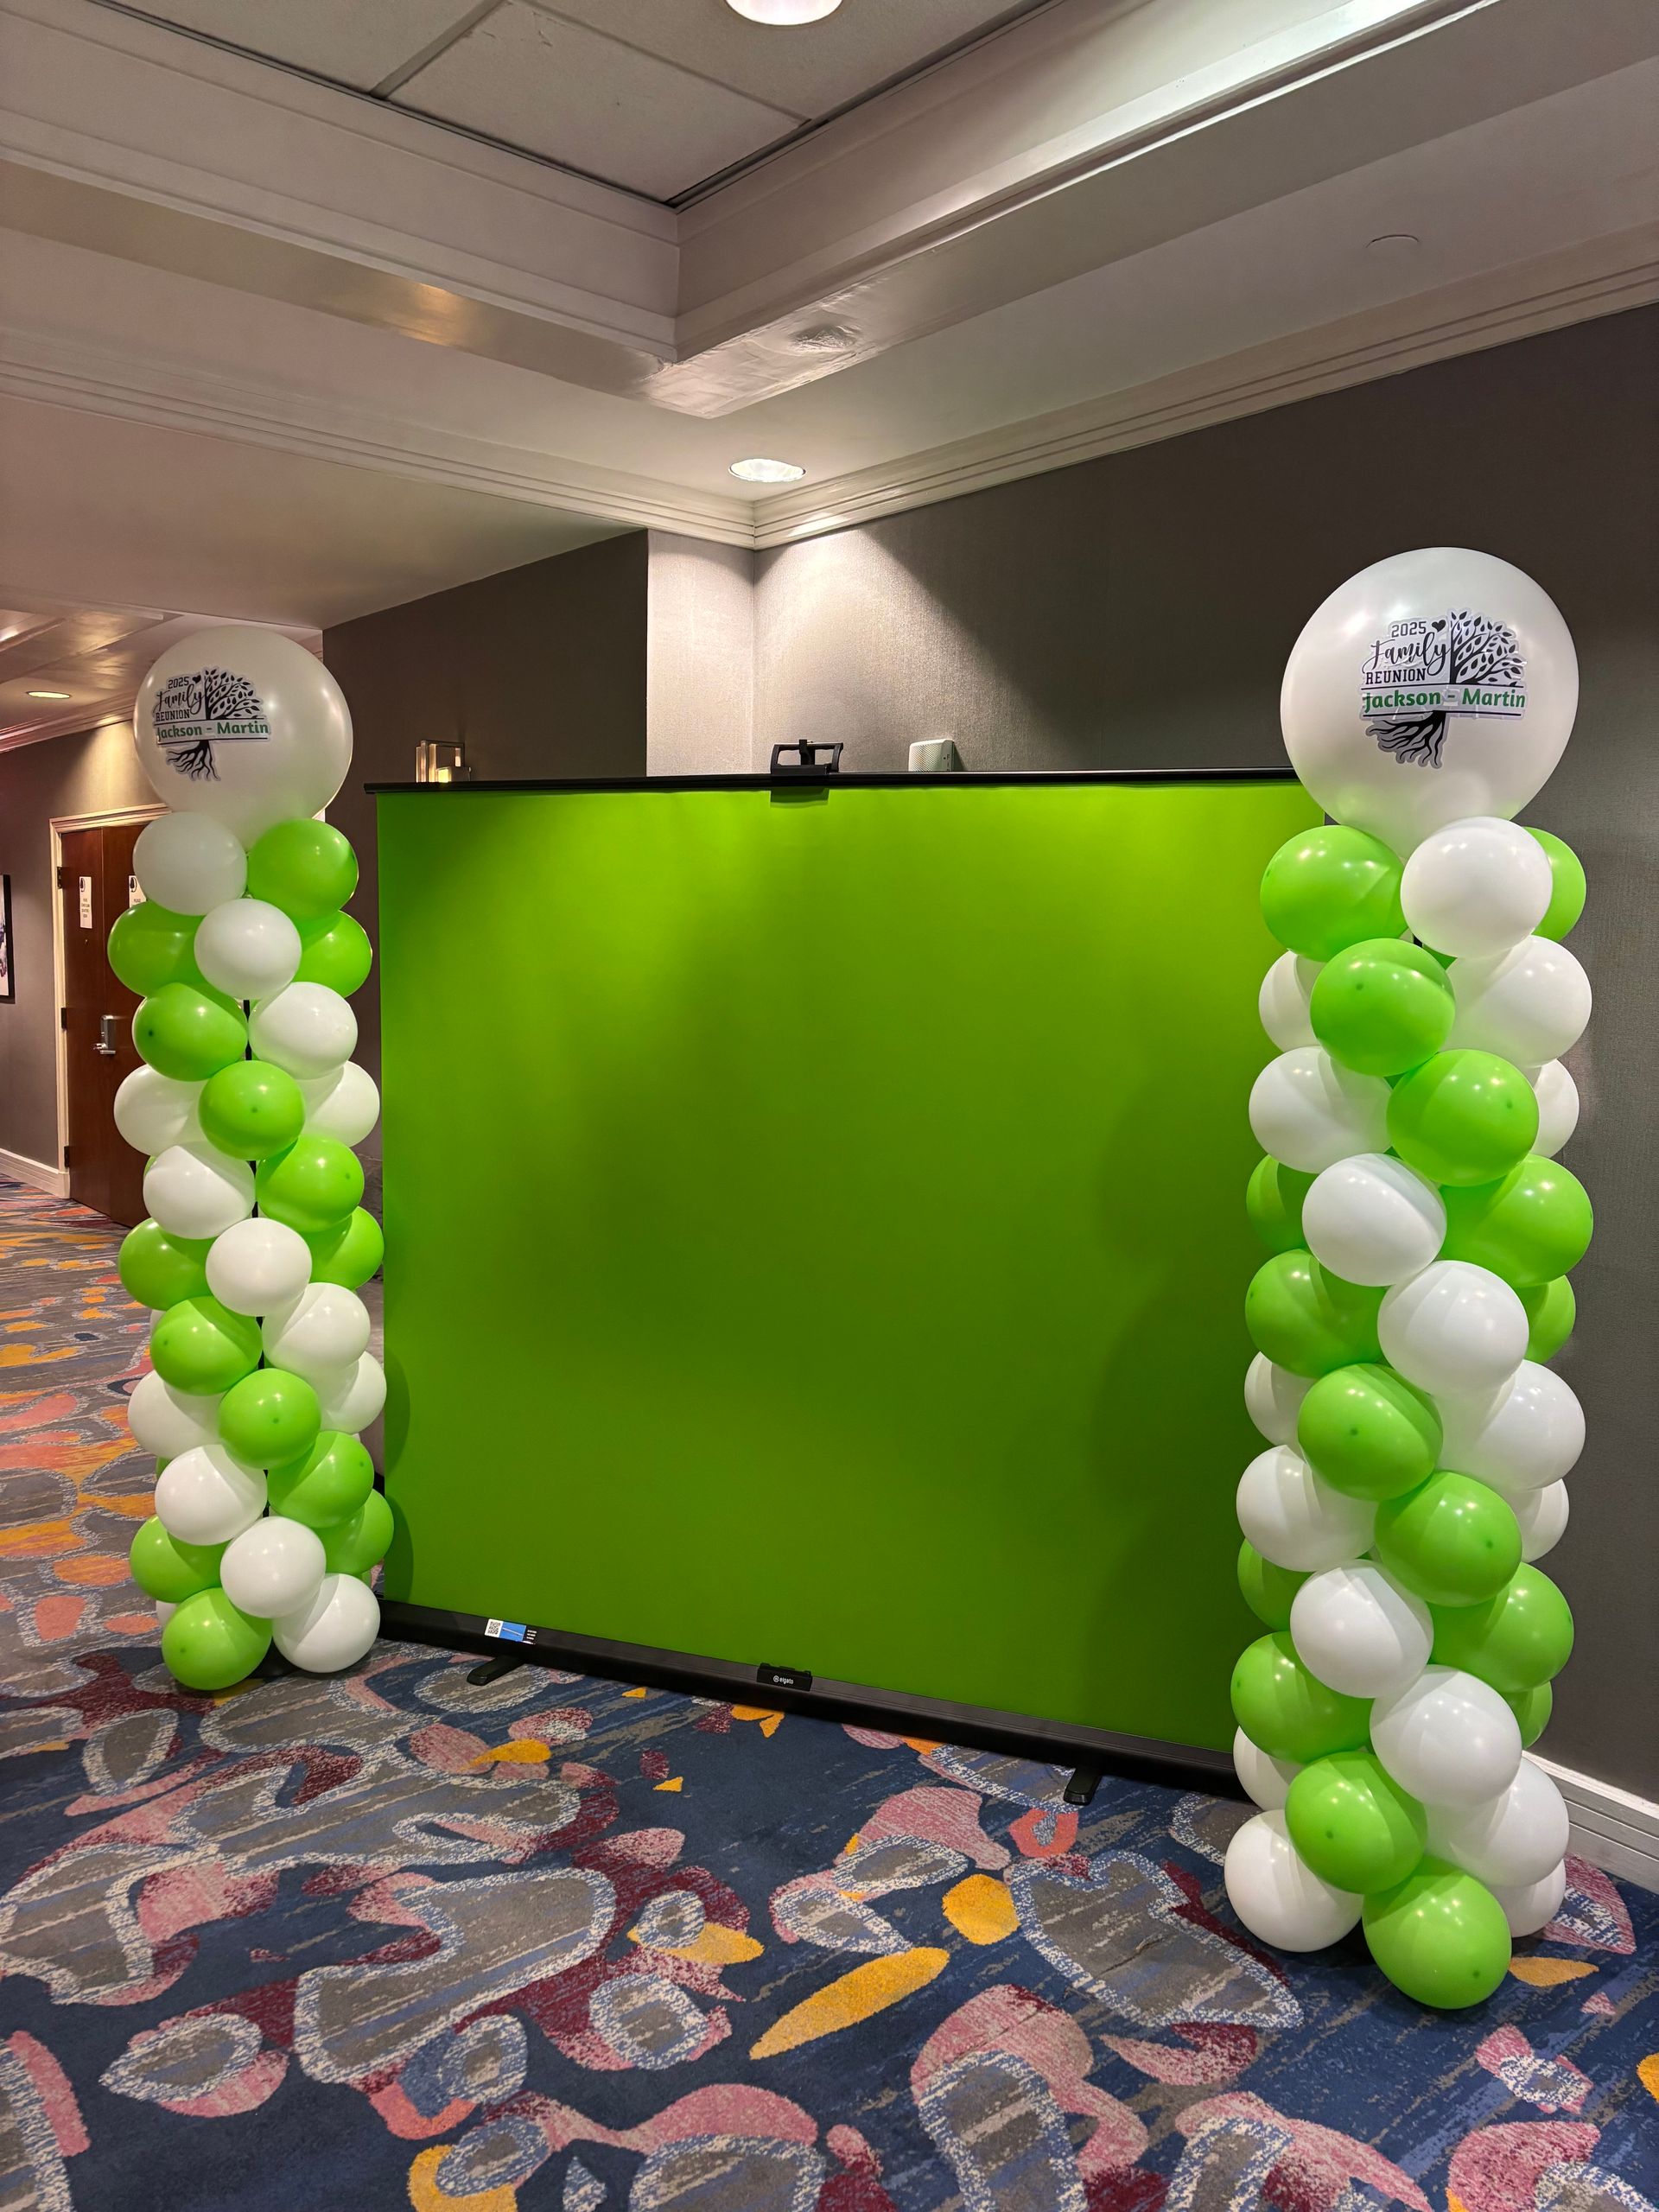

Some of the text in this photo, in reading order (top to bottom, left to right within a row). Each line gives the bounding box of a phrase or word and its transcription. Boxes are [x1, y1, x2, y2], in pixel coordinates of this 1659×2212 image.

[1391, 620, 1427, 639] 2025
[1361, 632, 1451, 677] Family
[168, 676, 190, 690] 2025
[1365, 667, 1427, 685] REUNION
[153, 683, 206, 715] Family
[1461, 688, 1526, 708] Martin
[156, 709, 191, 722] REUNION
[156, 724, 203, 742] Jackson
[216, 721, 270, 734] Martin
